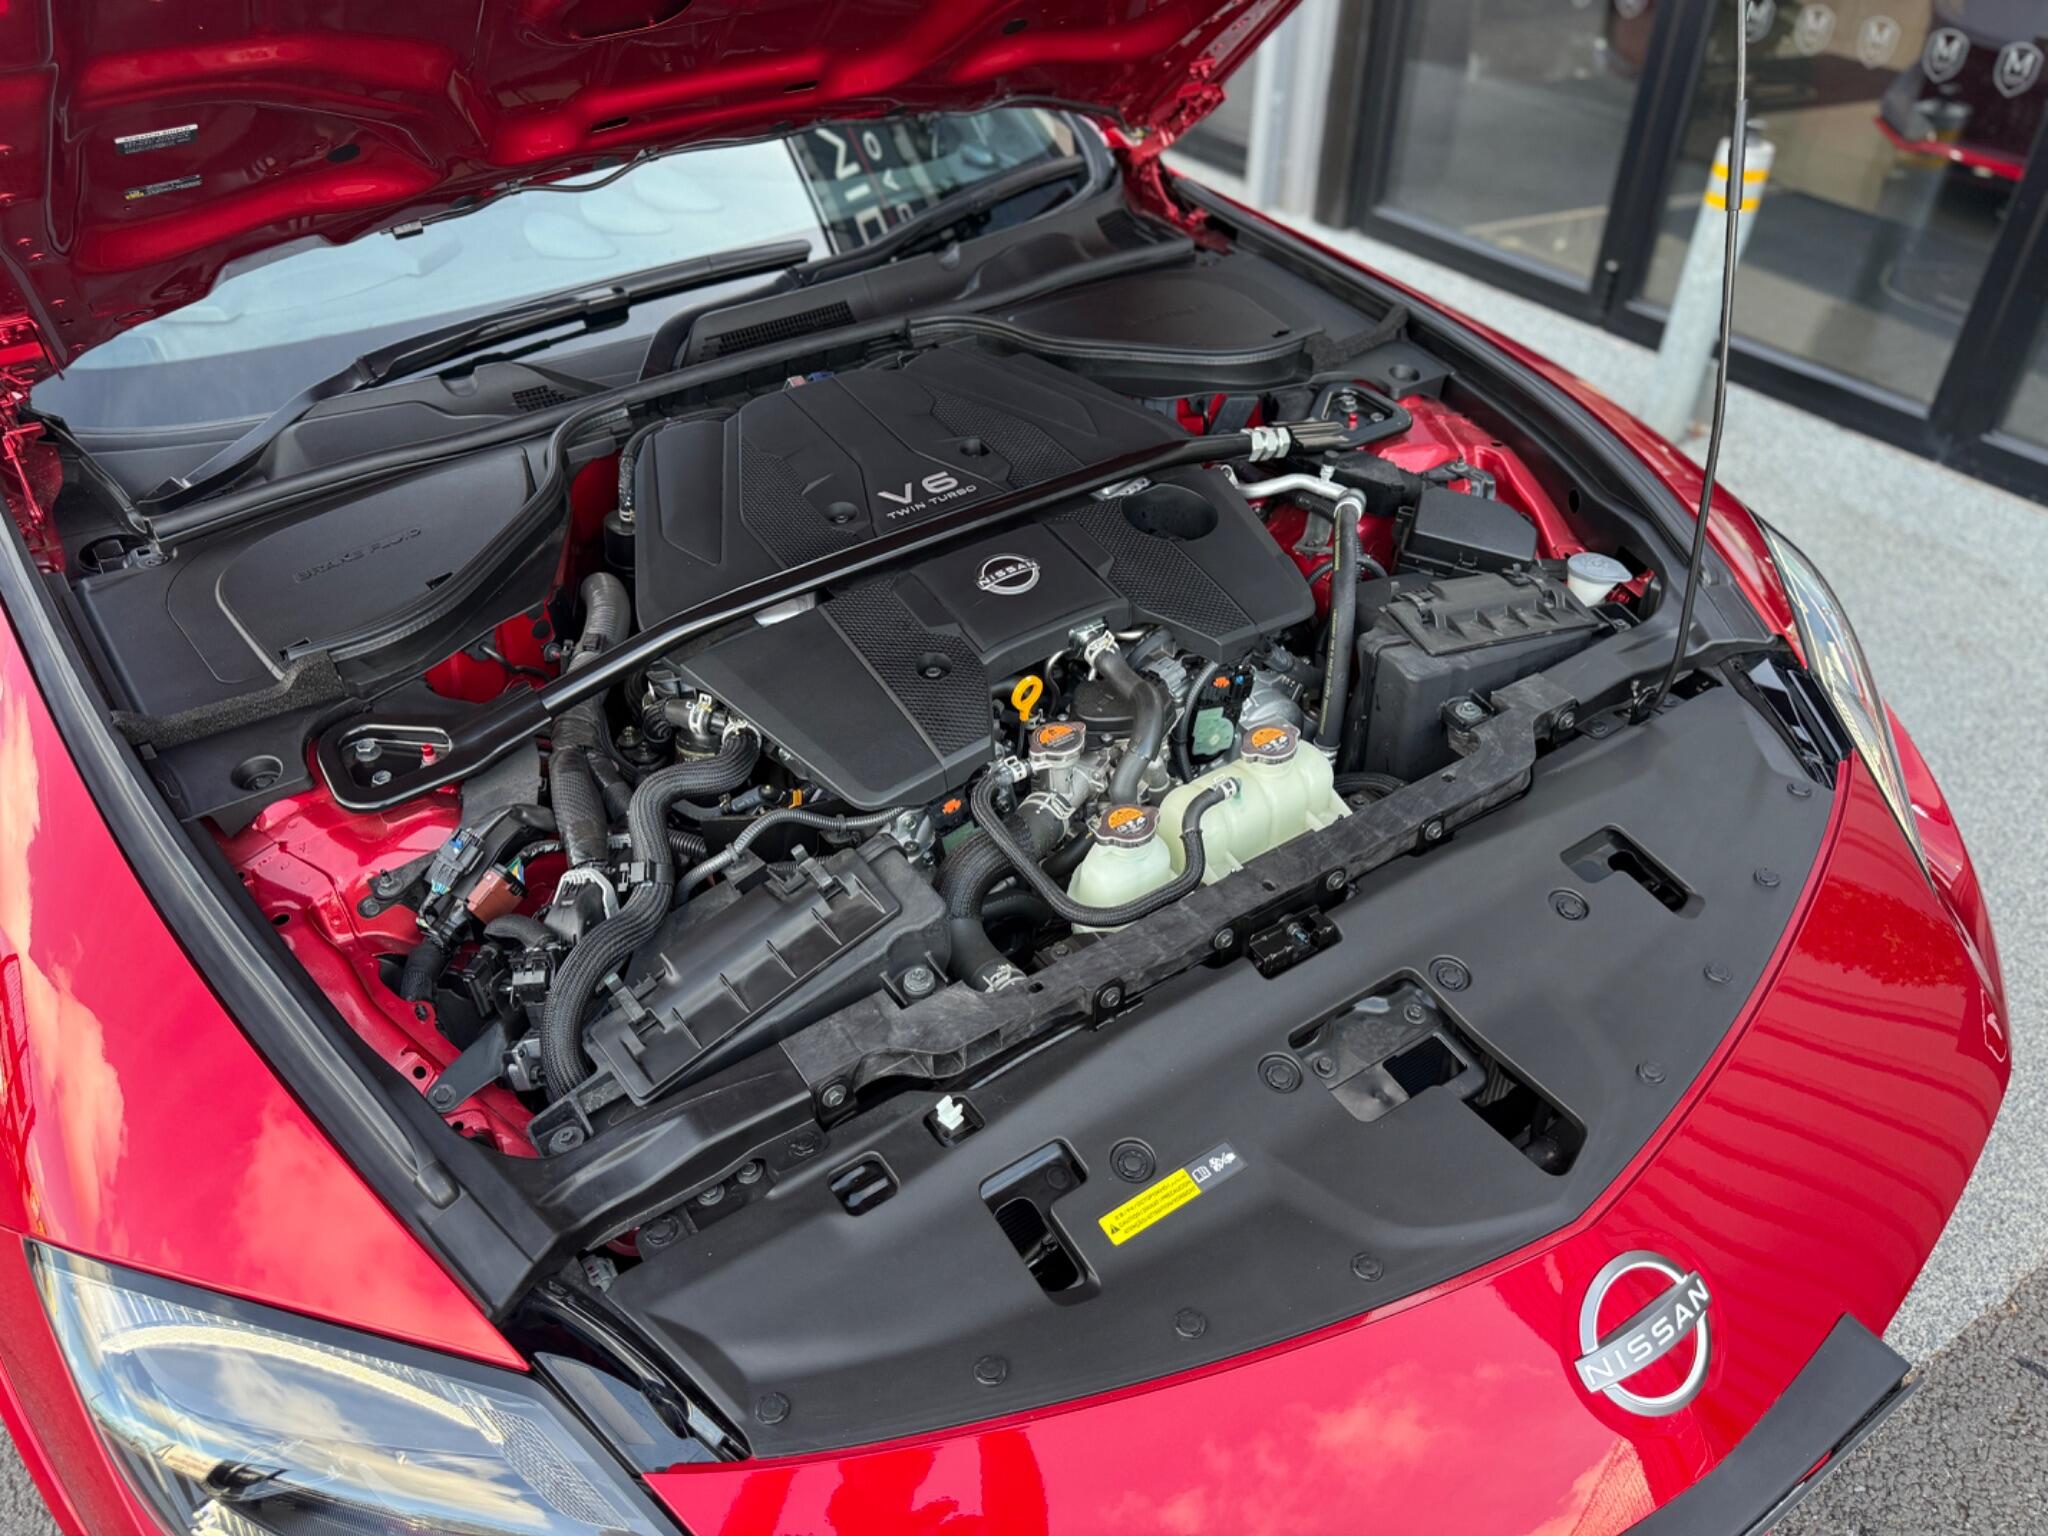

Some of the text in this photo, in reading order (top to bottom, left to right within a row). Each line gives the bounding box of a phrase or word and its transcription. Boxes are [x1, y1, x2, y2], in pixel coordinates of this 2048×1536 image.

[1932, 32, 1962, 62] M
[2003, 48, 2036, 77] M
[877, 470, 958, 504] V6
[886, 484, 977, 519] TWIN TURBO
[978, 560, 1038, 588] NISSAN
[1584, 1278, 1709, 1386] NISSAN
